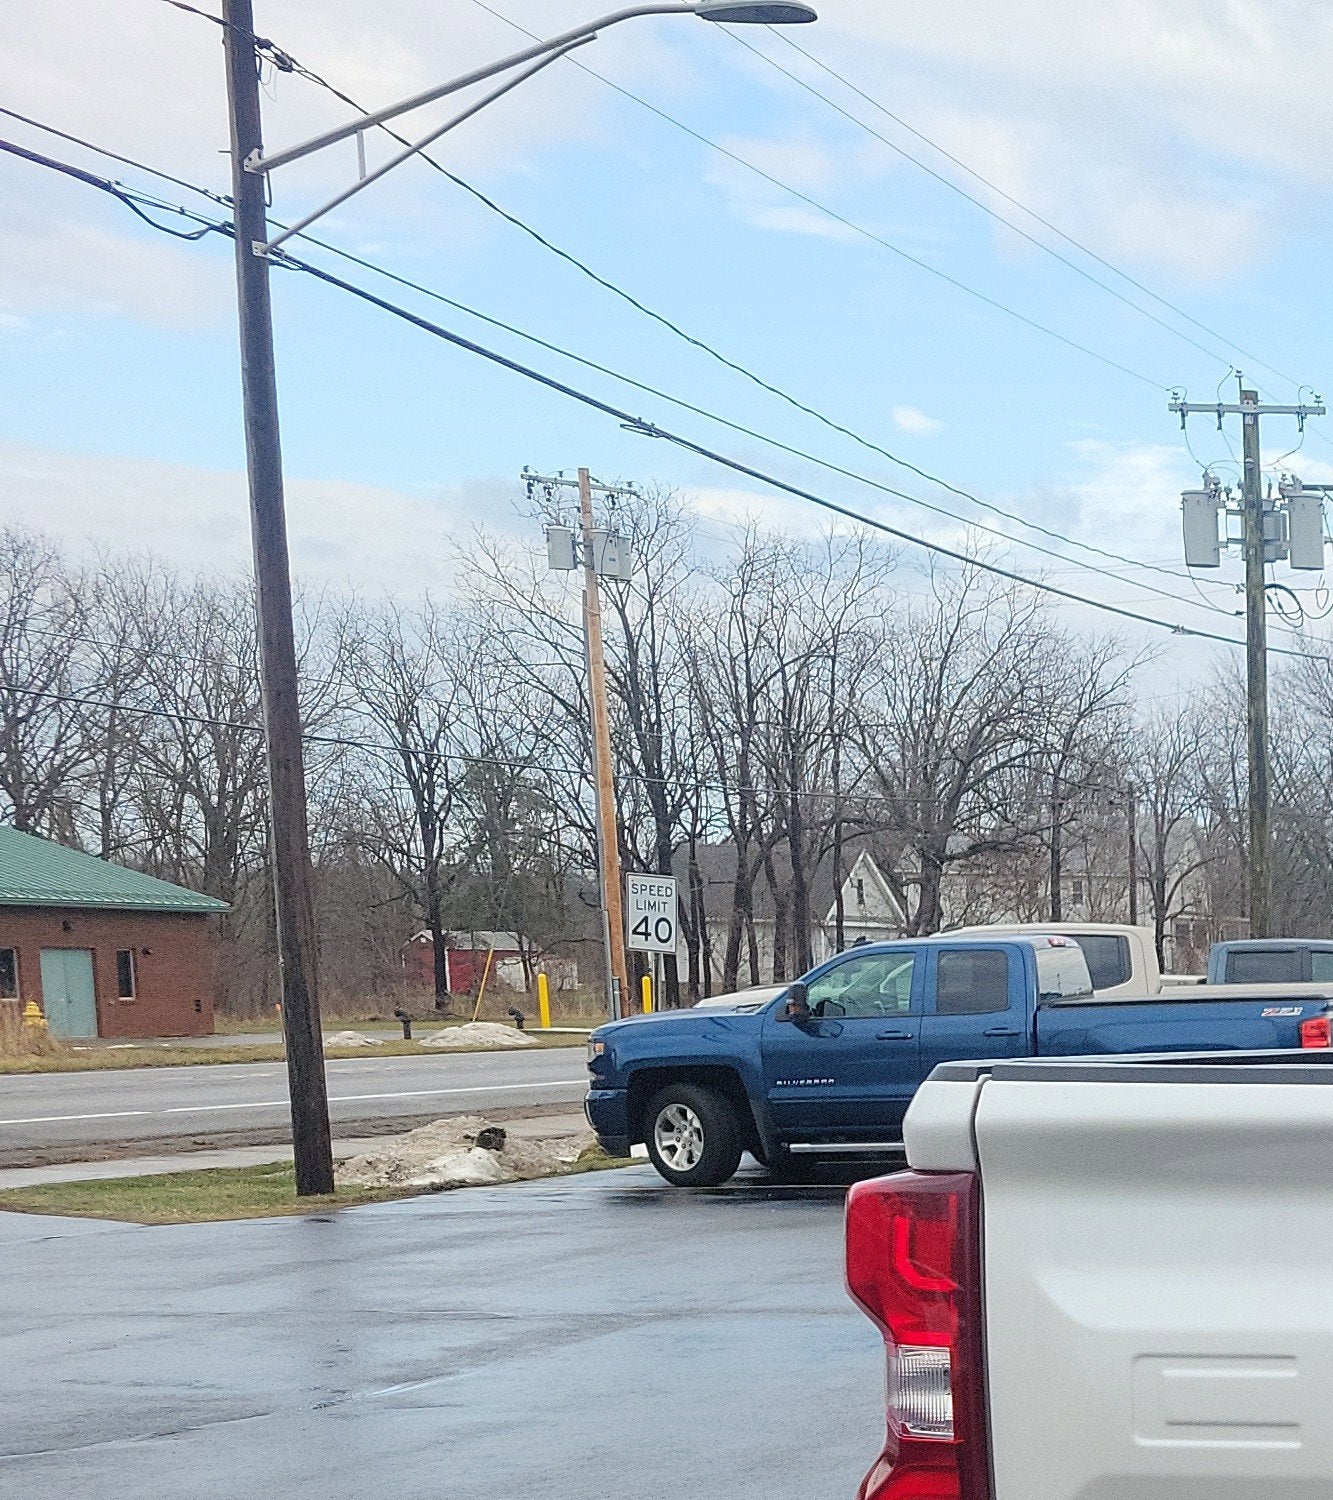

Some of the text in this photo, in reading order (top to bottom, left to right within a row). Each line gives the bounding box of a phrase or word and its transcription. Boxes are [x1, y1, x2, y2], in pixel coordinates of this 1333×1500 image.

[631, 883, 673, 897] SPEED
[636, 899, 668, 913] LIMIT
[632, 915, 673, 944] 40
